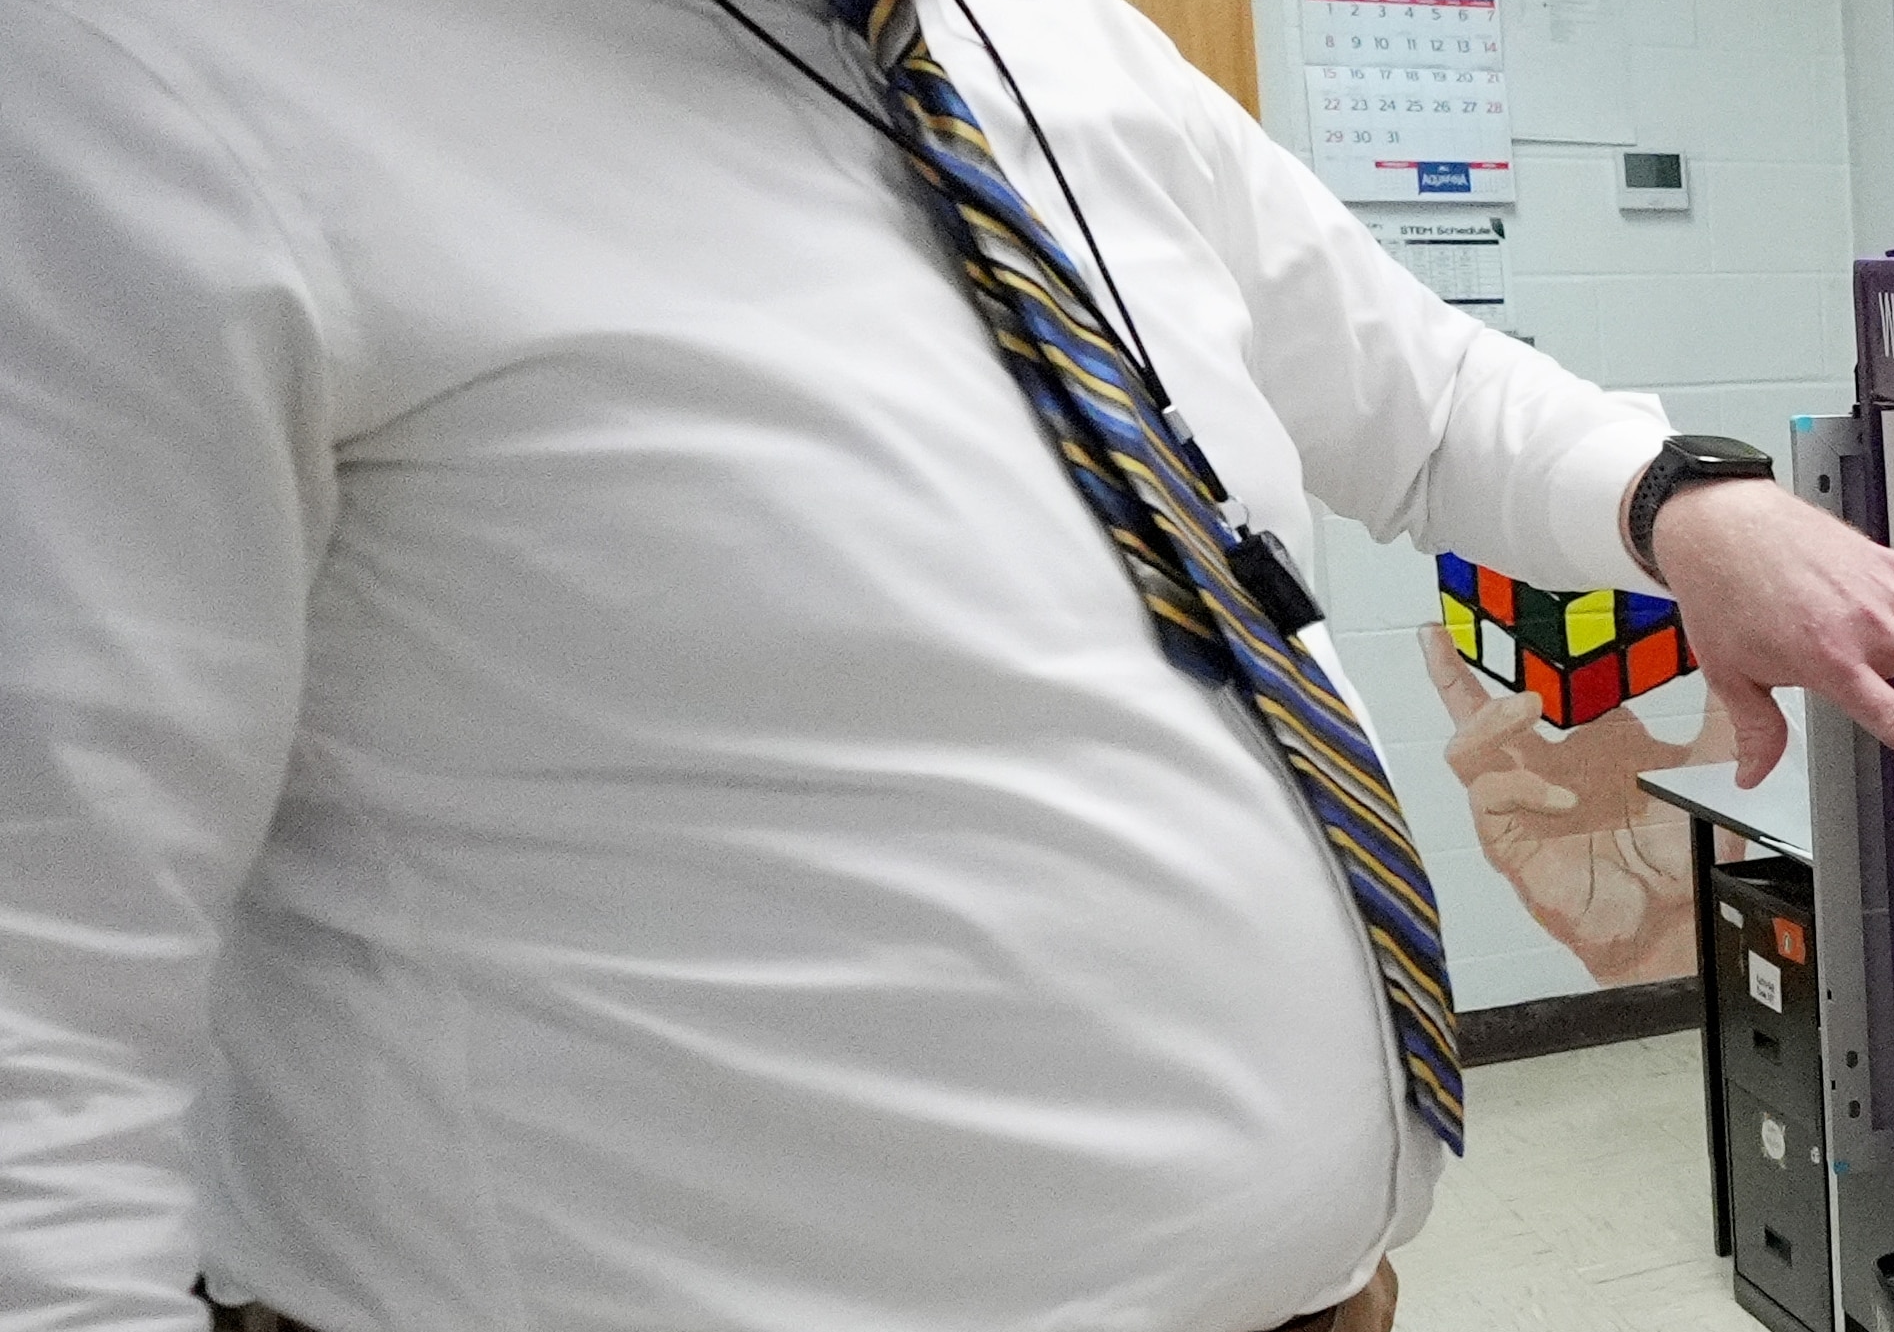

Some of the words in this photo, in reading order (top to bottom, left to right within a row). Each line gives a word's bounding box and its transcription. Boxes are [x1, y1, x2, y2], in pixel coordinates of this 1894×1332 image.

[1327, 4, 1333, 16] 1
[1351, 4, 1359, 16] 2
[1378, 6, 1386, 18] 3
[1404, 7, 1414, 19] 4
[1431, 8, 1441, 20] 5
[1458, 9, 1468, 20] 6
[1487, 10, 1495, 22] 7
[1325, 36, 1335, 48] 8
[1351, 36, 1361, 48] 9
[1374, 37, 1388, 50] 10
[1407, 38, 1416, 50] 11
[1431, 39, 1444, 52] 12
[1457, 40, 1470, 52] 13
[1484, 41, 1497, 52] 14
[1323, 68, 1337, 78] 15
[1350, 68, 1365, 80] 16
[1379, 69, 1392, 80] 17
[1405, 70, 1419, 81] 18
[1433, 71, 1446, 82] 19
[1456, 71, 1473, 83] 20
[1487, 72, 1501, 83] 21
[1323, 99, 1341, 110] 22
[1351, 99, 1368, 111] 23
[1379, 100, 1396, 111] 24
[1405, 100, 1423, 112] 25
[1433, 101, 1451, 113] 26
[1463, 101, 1477, 113] 27
[1486, 101, 1503, 113] 28
[1325, 131, 1343, 142] 29
[1353, 131, 1372, 143] 30
[1386, 131, 1400, 143] 31
[1401, 225, 1433, 235] STEM
[1437, 225, 1492, 235] Schedule
